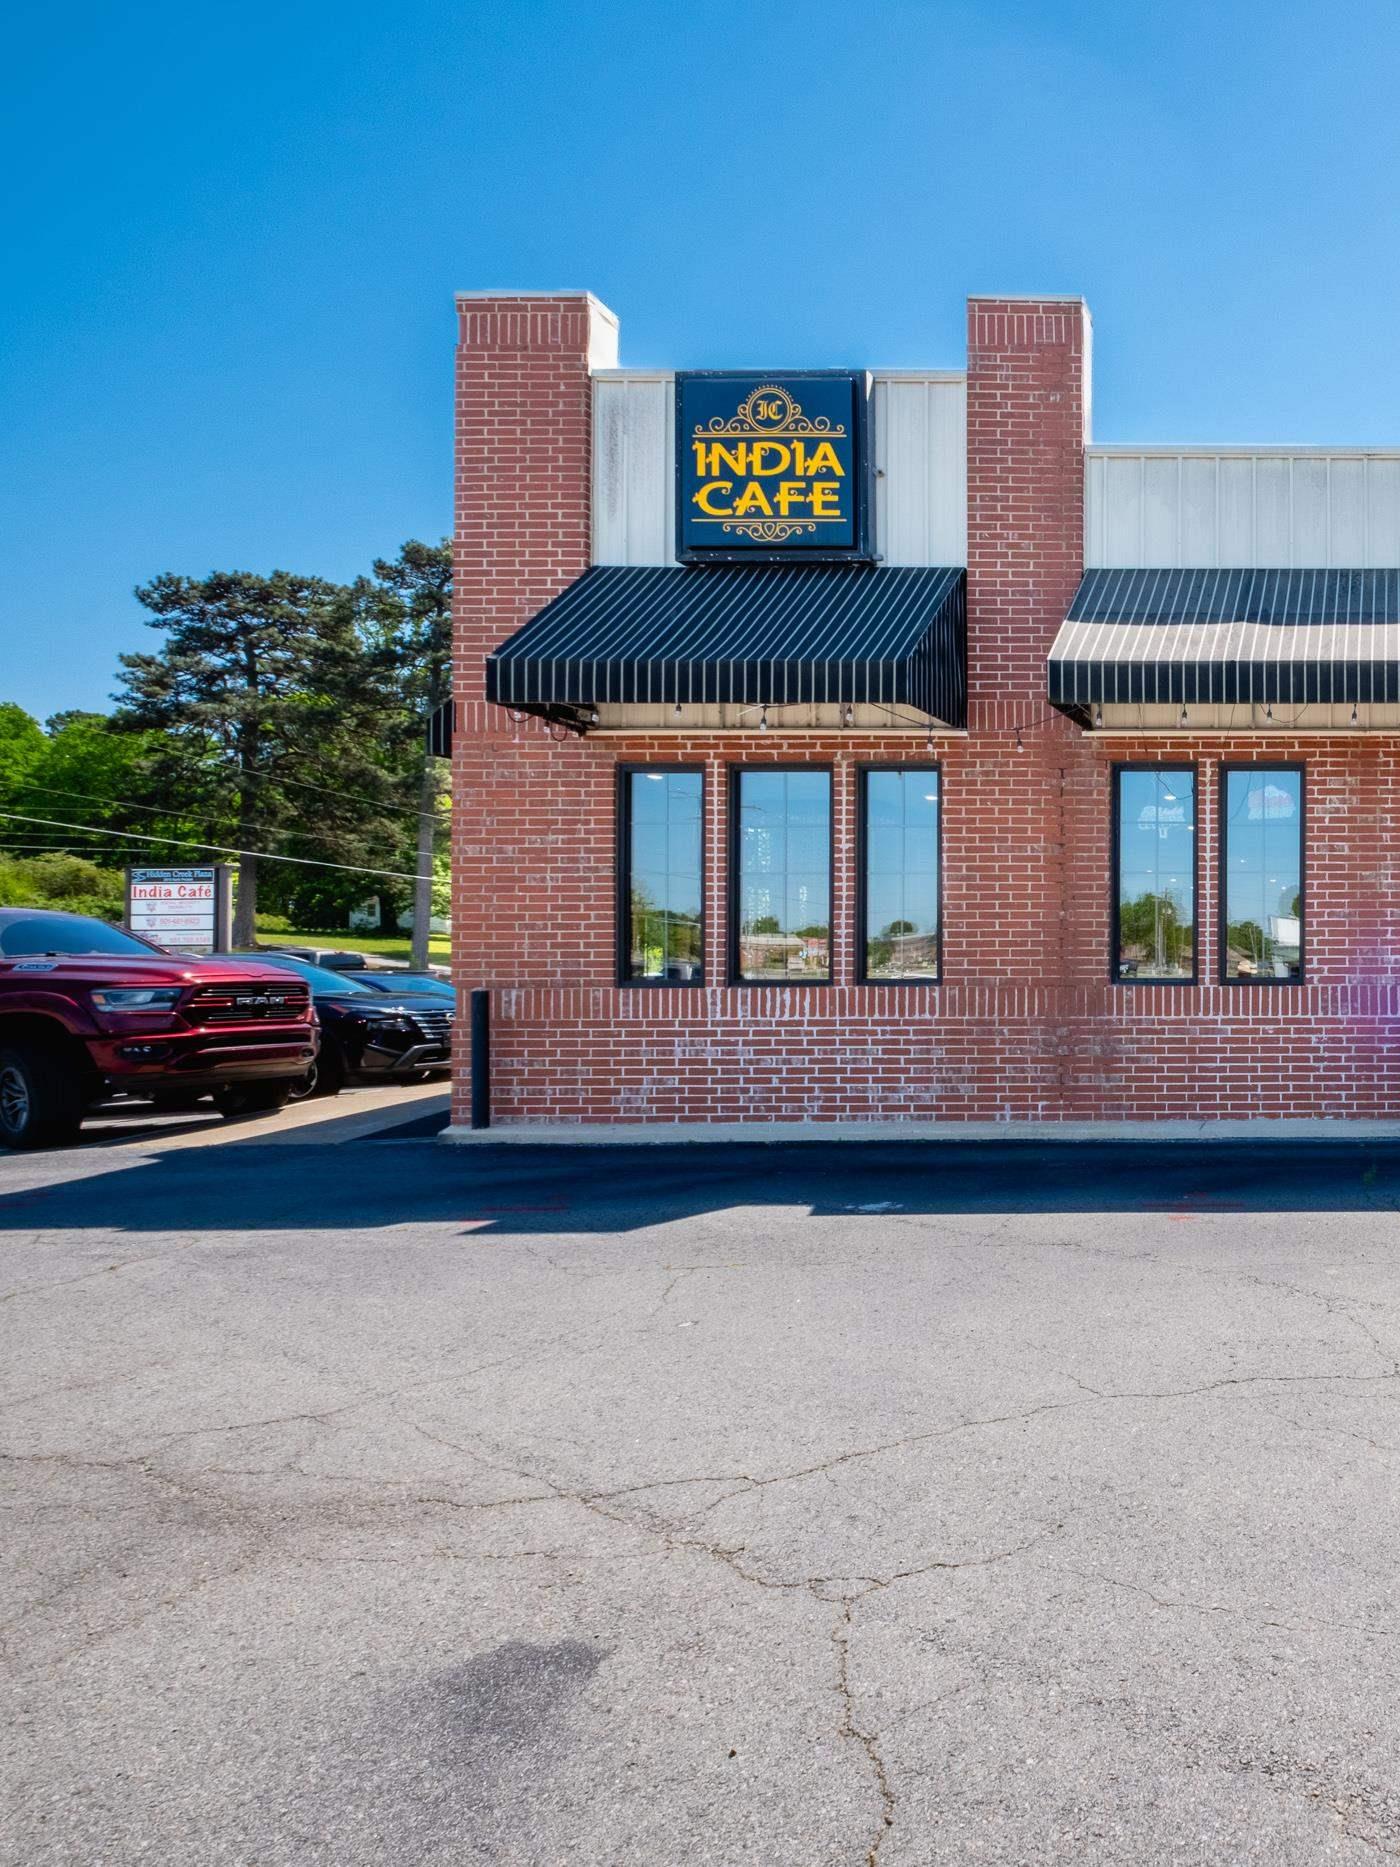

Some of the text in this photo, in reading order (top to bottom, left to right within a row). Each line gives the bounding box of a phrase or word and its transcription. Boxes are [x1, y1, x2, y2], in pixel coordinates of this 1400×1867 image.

[692, 440, 845, 476] INDIA
[692, 481, 841, 516] CAFE
[133, 885, 172, 898] India
[236, 996, 285, 1005] RAM
